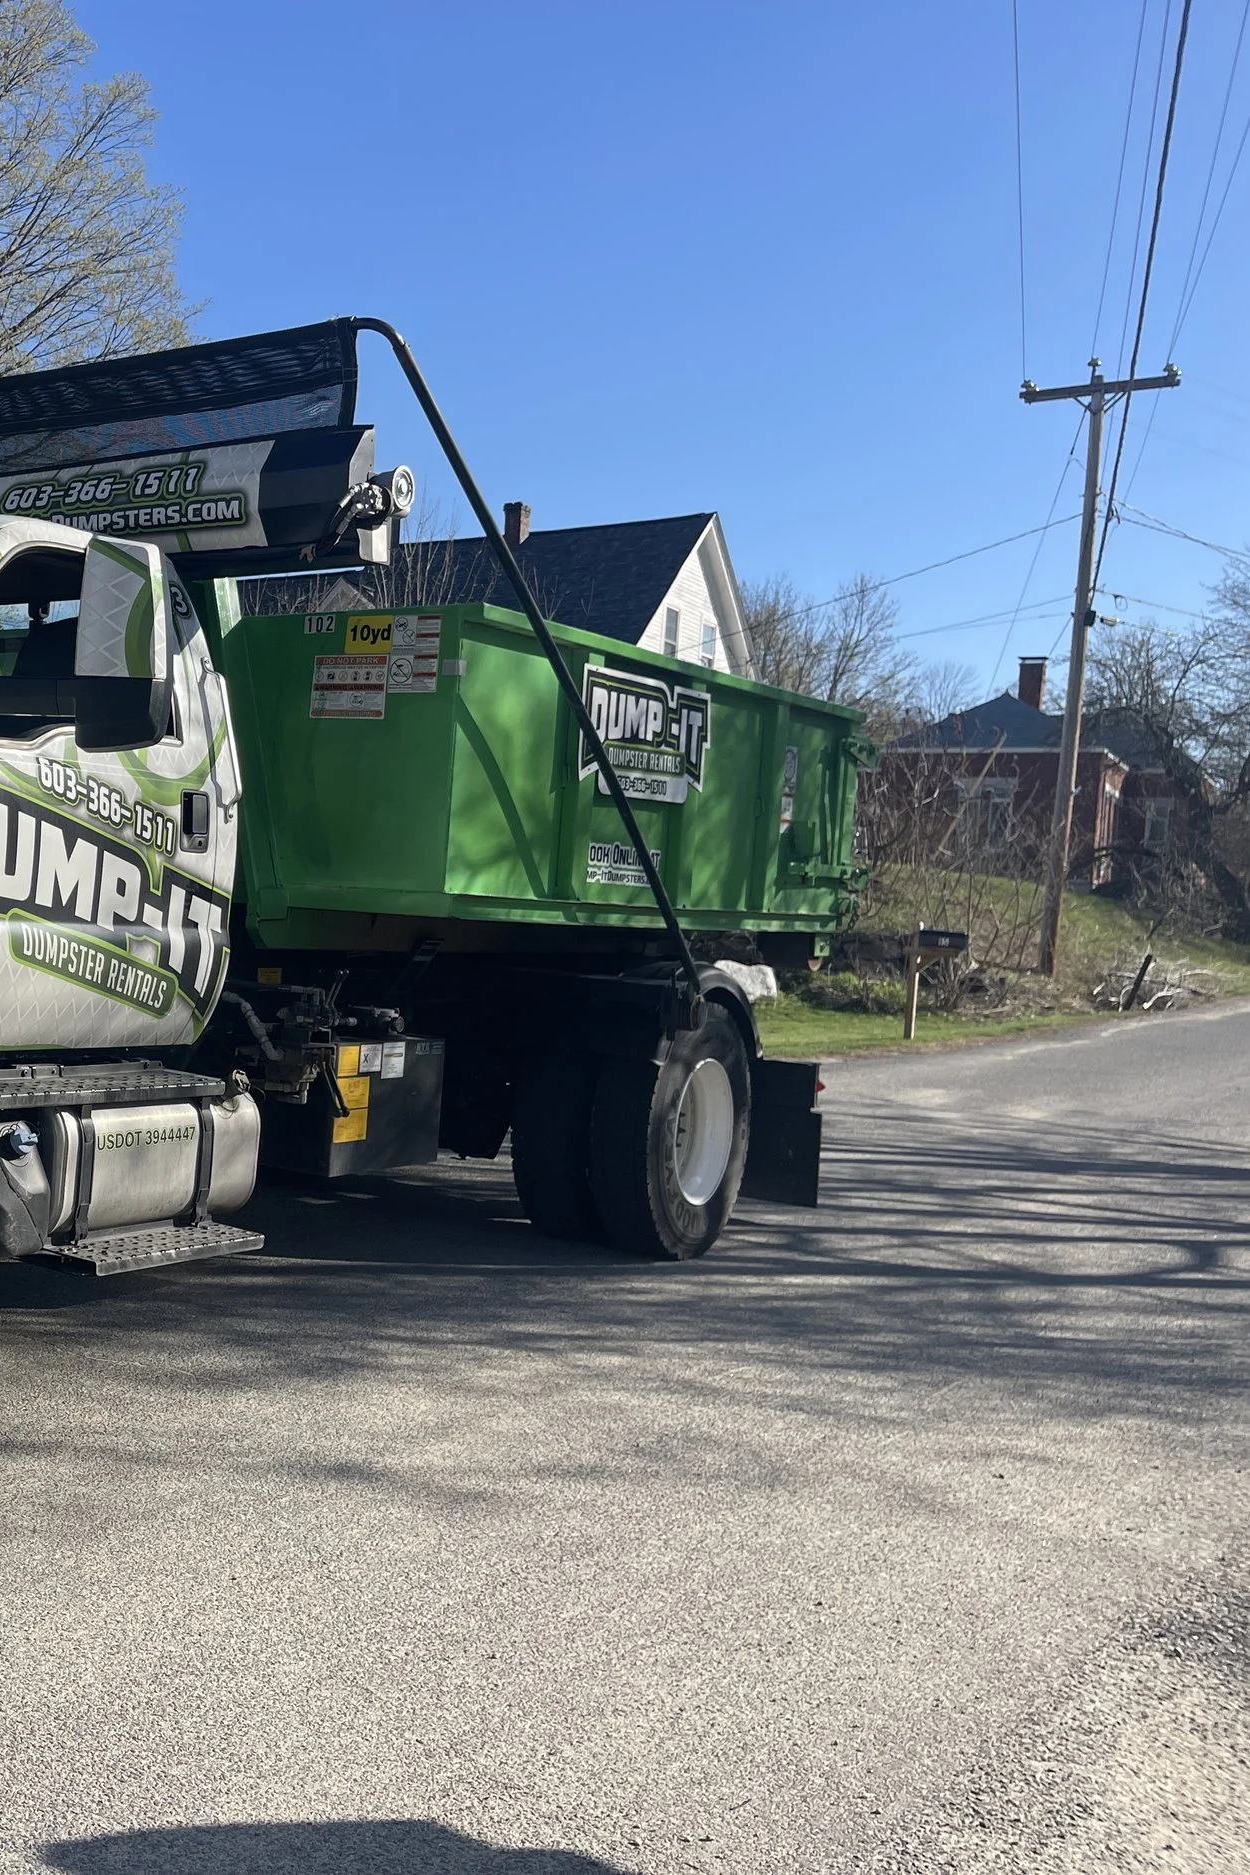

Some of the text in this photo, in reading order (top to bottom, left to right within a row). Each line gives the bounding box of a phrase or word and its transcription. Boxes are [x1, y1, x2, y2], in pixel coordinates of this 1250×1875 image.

[4, 467, 199, 511] 603-366-1511
[307, 615, 334, 633] 102
[350, 623, 392, 645] 10yd
[323, 656, 379, 665] DO NOT PARK
[591, 685, 703, 765] DUMP-IT
[608, 747, 681, 774] DUMPSTER RENTALS
[39, 757, 175, 854] 603-366-1511
[589, 844, 611, 865] OOK
[611, 843, 642, 868] ONLIN
[20, 921, 168, 1010] DUMPSTER RENTALS
[97, 1126, 196, 1150] USDOT 3944447
